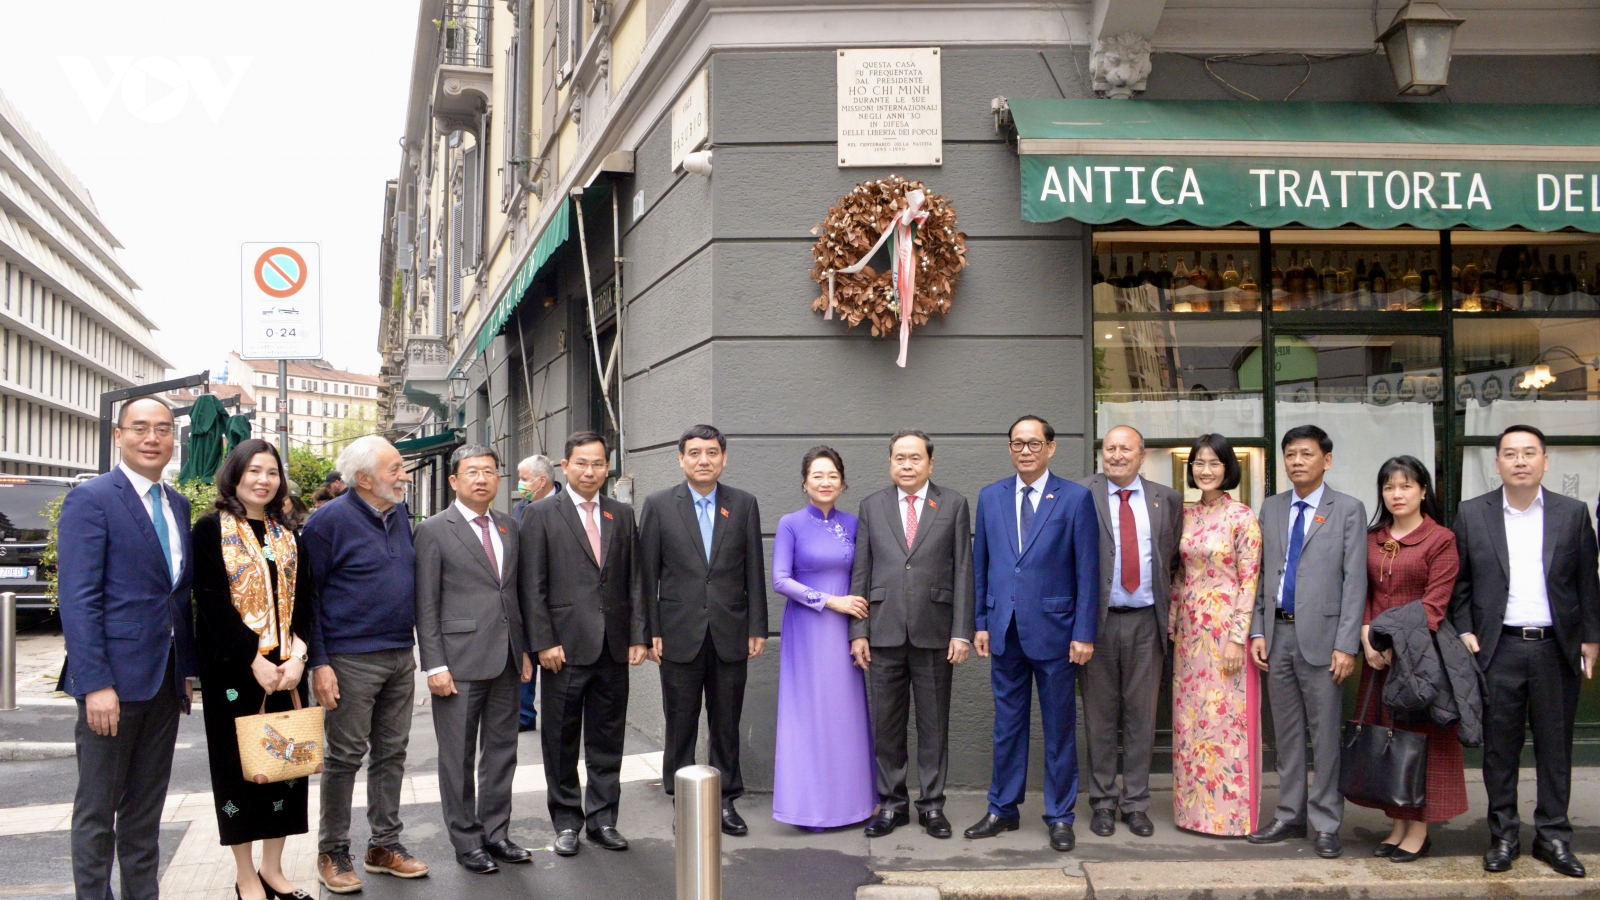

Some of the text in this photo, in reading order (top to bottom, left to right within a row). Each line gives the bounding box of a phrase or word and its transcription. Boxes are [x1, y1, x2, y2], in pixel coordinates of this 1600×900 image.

[862, 61, 892, 69] QUESTA
[869, 69, 923, 77] FREQUENTATA
[848, 85, 930, 96] HO CHI MINH
[876, 104, 938, 112] INTERNAZIONALI
[673, 112, 702, 156] PASUBIO
[911, 128, 938, 136] POPOLI
[1040, 165, 1204, 205] ANTICA
[1249, 168, 1492, 210] TRATTORIA
